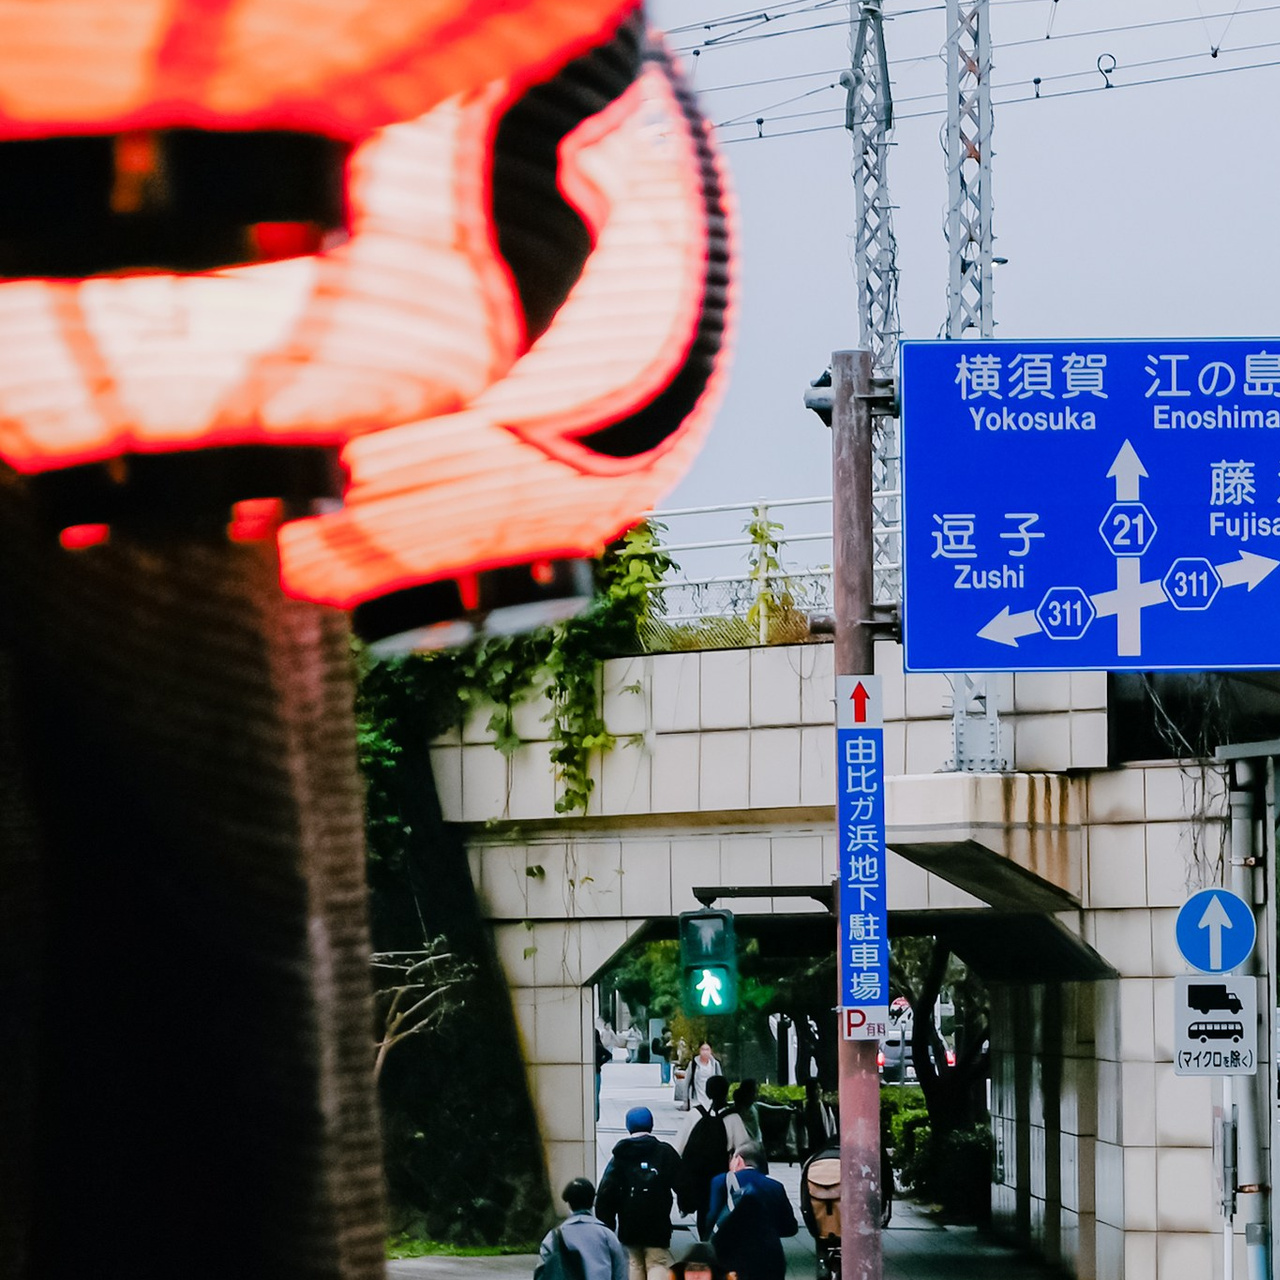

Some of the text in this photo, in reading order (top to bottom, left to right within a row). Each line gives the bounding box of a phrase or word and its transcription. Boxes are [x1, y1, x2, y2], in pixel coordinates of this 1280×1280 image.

[955, 352, 1108, 401] 横須賀
[969, 406, 1097, 431] Yokosuka
[1153, 405, 1280, 429] Enoshima
[931, 513, 1046, 559] 逗子
[1112, 513, 1146, 547] 21
[954, 565, 1025, 589] Zushi
[1173, 570, 1209, 598] 311
[1047, 600, 1083, 628] 311
[845, 735, 882, 1001] 由比ガ浜地下駐車場
[848, 1010, 886, 1037] P 有料
